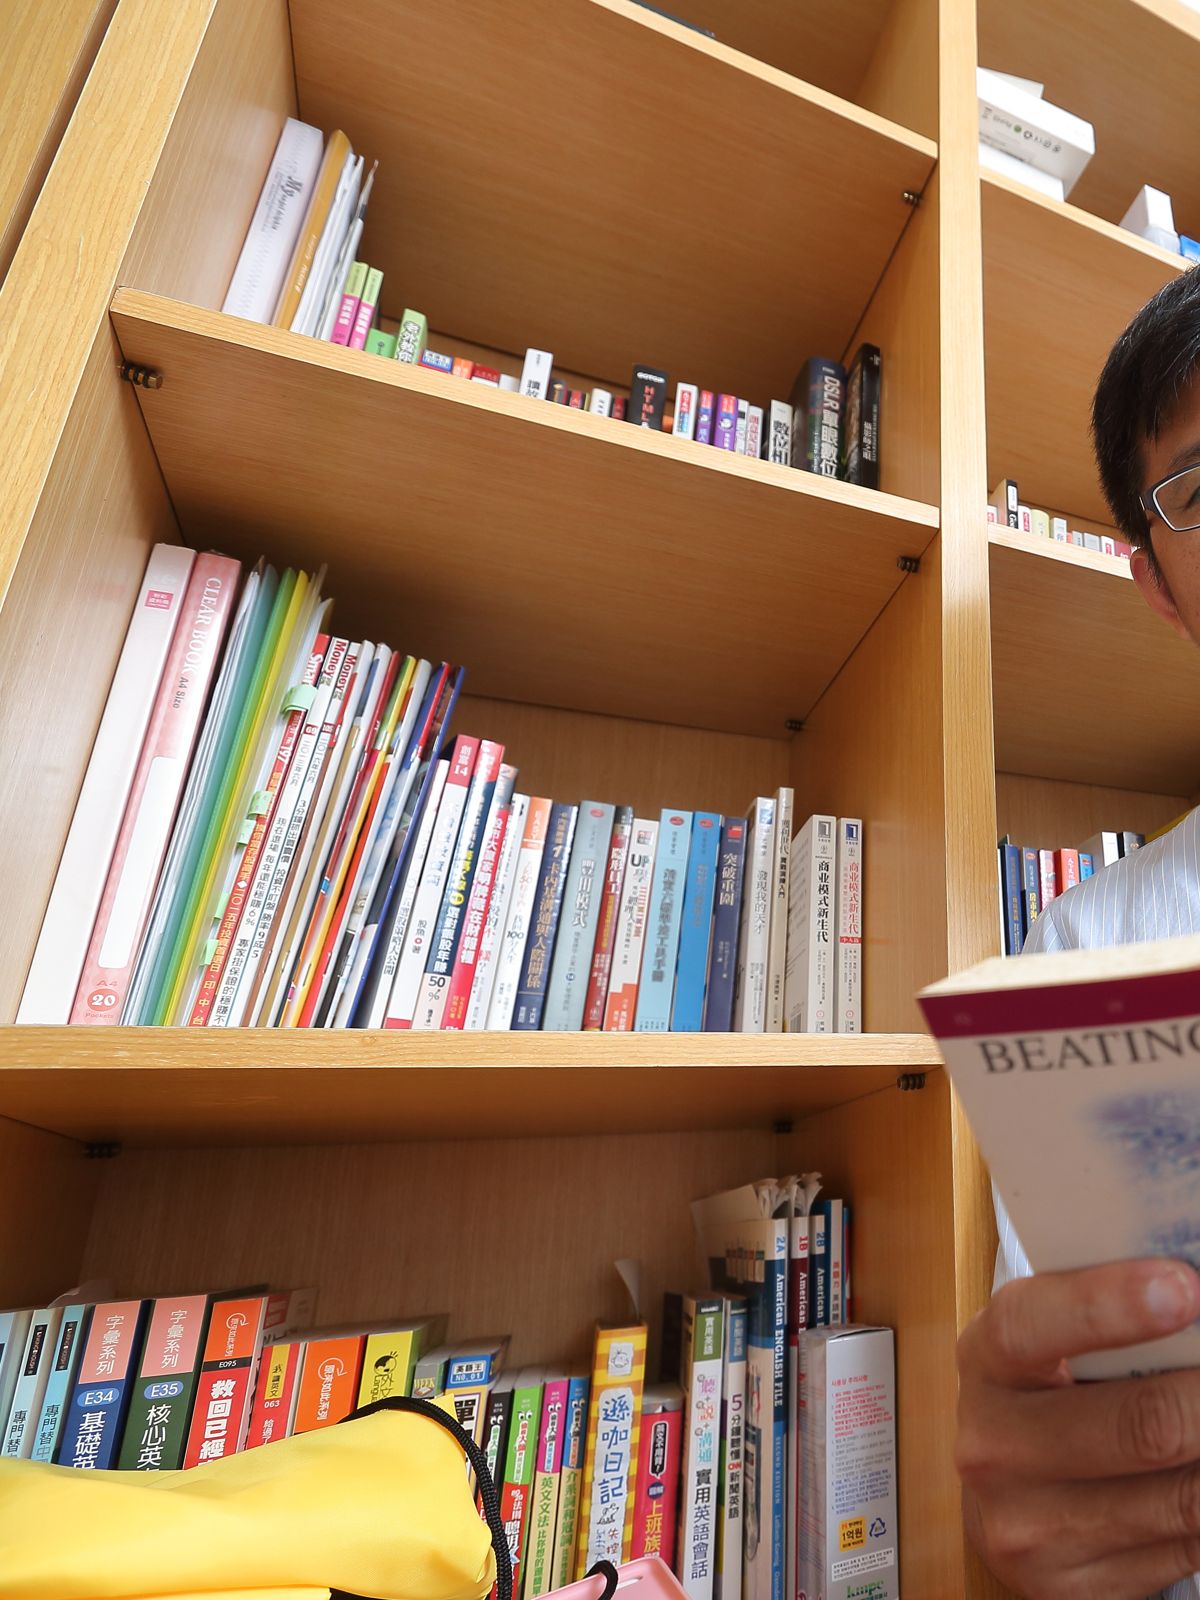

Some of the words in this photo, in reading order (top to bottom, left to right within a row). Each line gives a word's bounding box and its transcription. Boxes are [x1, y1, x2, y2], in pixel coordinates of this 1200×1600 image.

[199, 576, 223, 625] CLEAR
[321, 640, 347, 681] Money
[337, 654, 358, 693] Money
[719, 853, 738, 907] 突破重圍
[753, 870, 769, 935] 發現我的天才
[816, 860, 830, 944] 商业模式新生代
[848, 862, 860, 935] 商业模式新生代
[91, 993, 117, 1009] 20
[775, 1236, 786, 1254] 2A
[798, 1235, 810, 1252] 1B
[816, 1231, 826, 1249] 2B
[775, 1273, 786, 1326] American
[798, 1271, 810, 1326] American
[816, 1267, 826, 1321] American
[95, 1314, 125, 1376] 字彙系列
[161, 1309, 189, 1369] 字彙系列
[218, 1360, 238, 1369] E095
[773, 1330, 785, 1378] ENGLISH
[150, 1383, 179, 1398] E35
[316, 1363, 336, 1421] 原來如此系列
[456, 1363, 484, 1374] 英語王
[773, 1381, 784, 1408] FILE
[84, 1391, 114, 1406] E34
[199, 1379, 238, 1466] 救回已經
[263, 1399, 281, 1410] 063
[6, 1410, 28, 1458] 專門替
[137, 1403, 172, 1471] 核心英
[597, 1394, 631, 1505] 遜咖日記
[537, 1476, 555, 1528] 英文文法
[644, 1499, 664, 1552] 上班族
[691, 1468, 713, 1580] 實用英語會話
